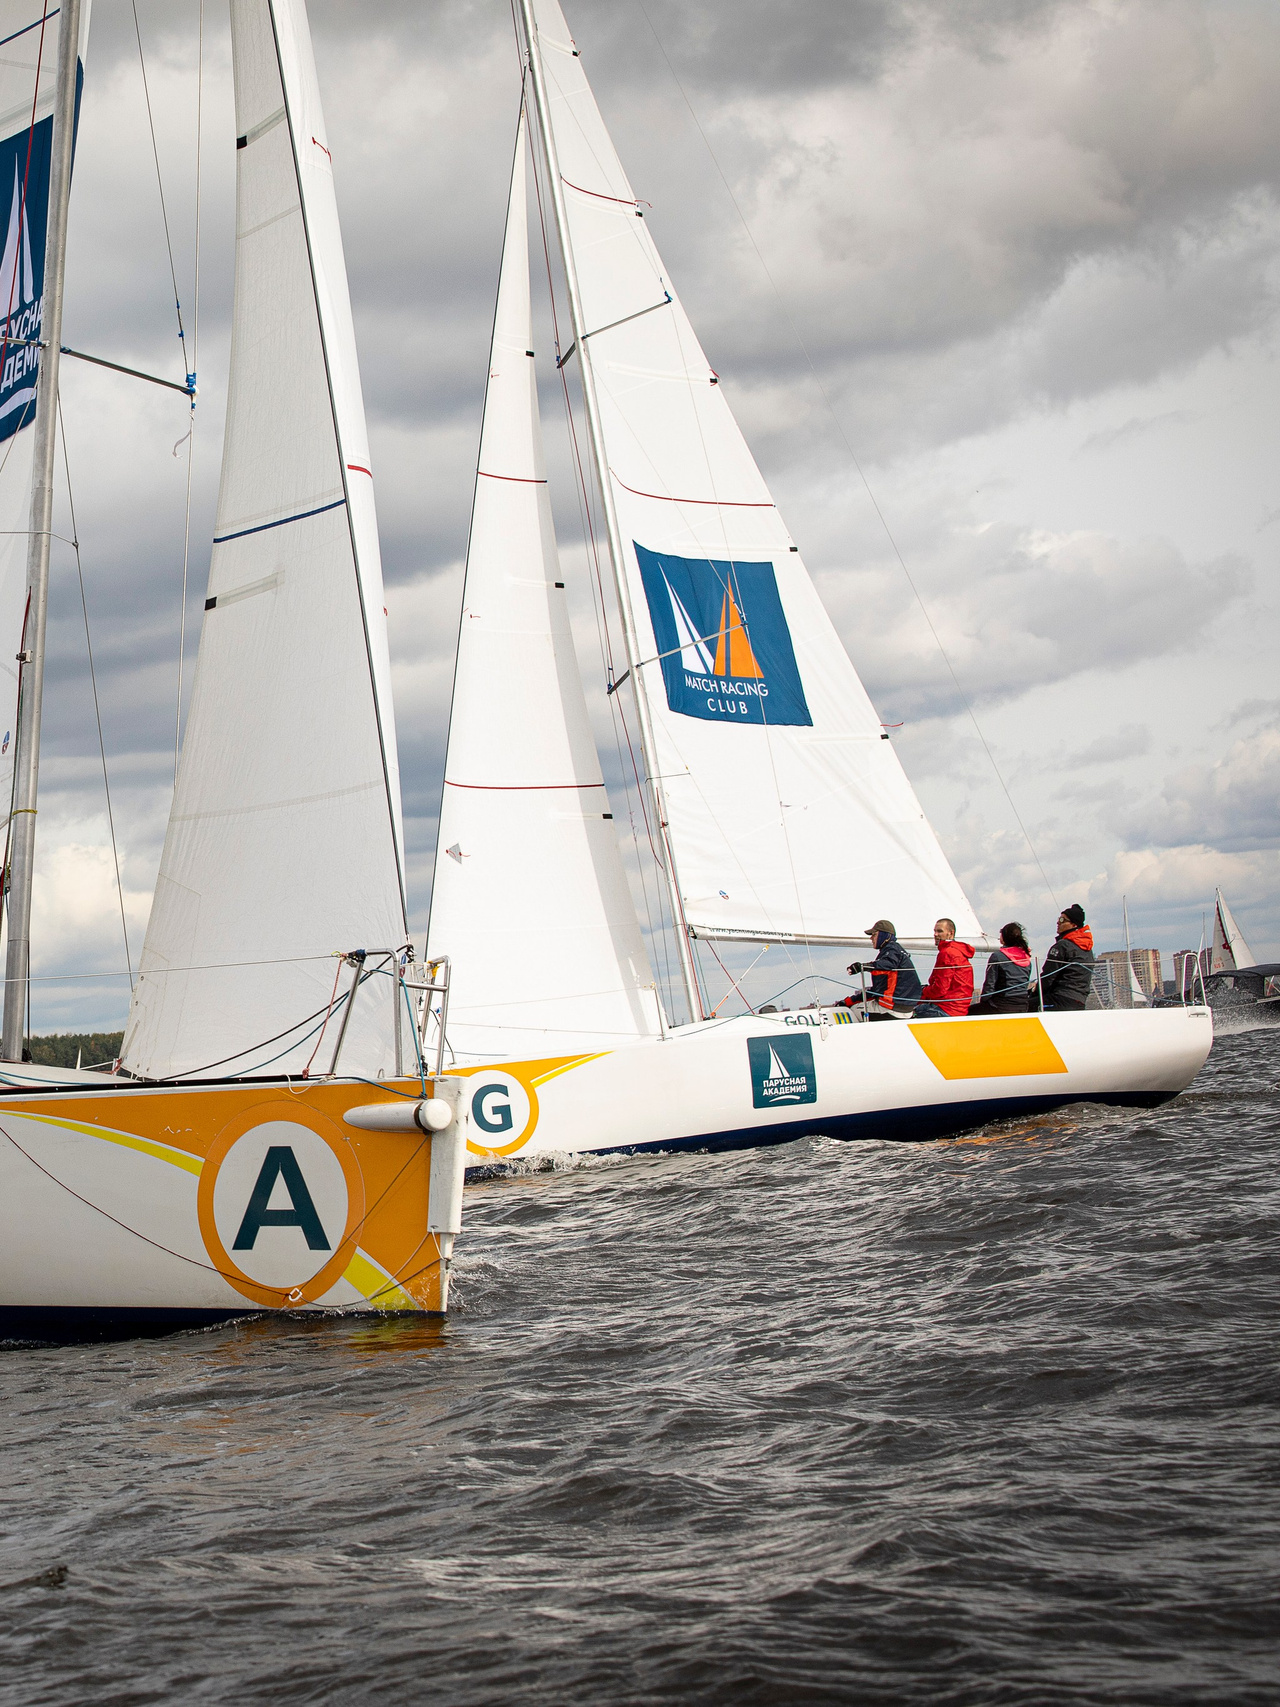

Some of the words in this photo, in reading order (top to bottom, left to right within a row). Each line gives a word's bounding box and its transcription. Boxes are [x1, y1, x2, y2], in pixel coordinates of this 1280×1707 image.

[685, 674, 719, 693] MATCH
[720, 681, 769, 697] RACING
[707, 698, 748, 714] CLUB
[763, 1076, 806, 1087] ПАРУСНАЯ
[763, 1085, 807, 1096] АКАДЕМИЯ
[471, 1084, 514, 1133] G
[232, 1146, 332, 1250] A
